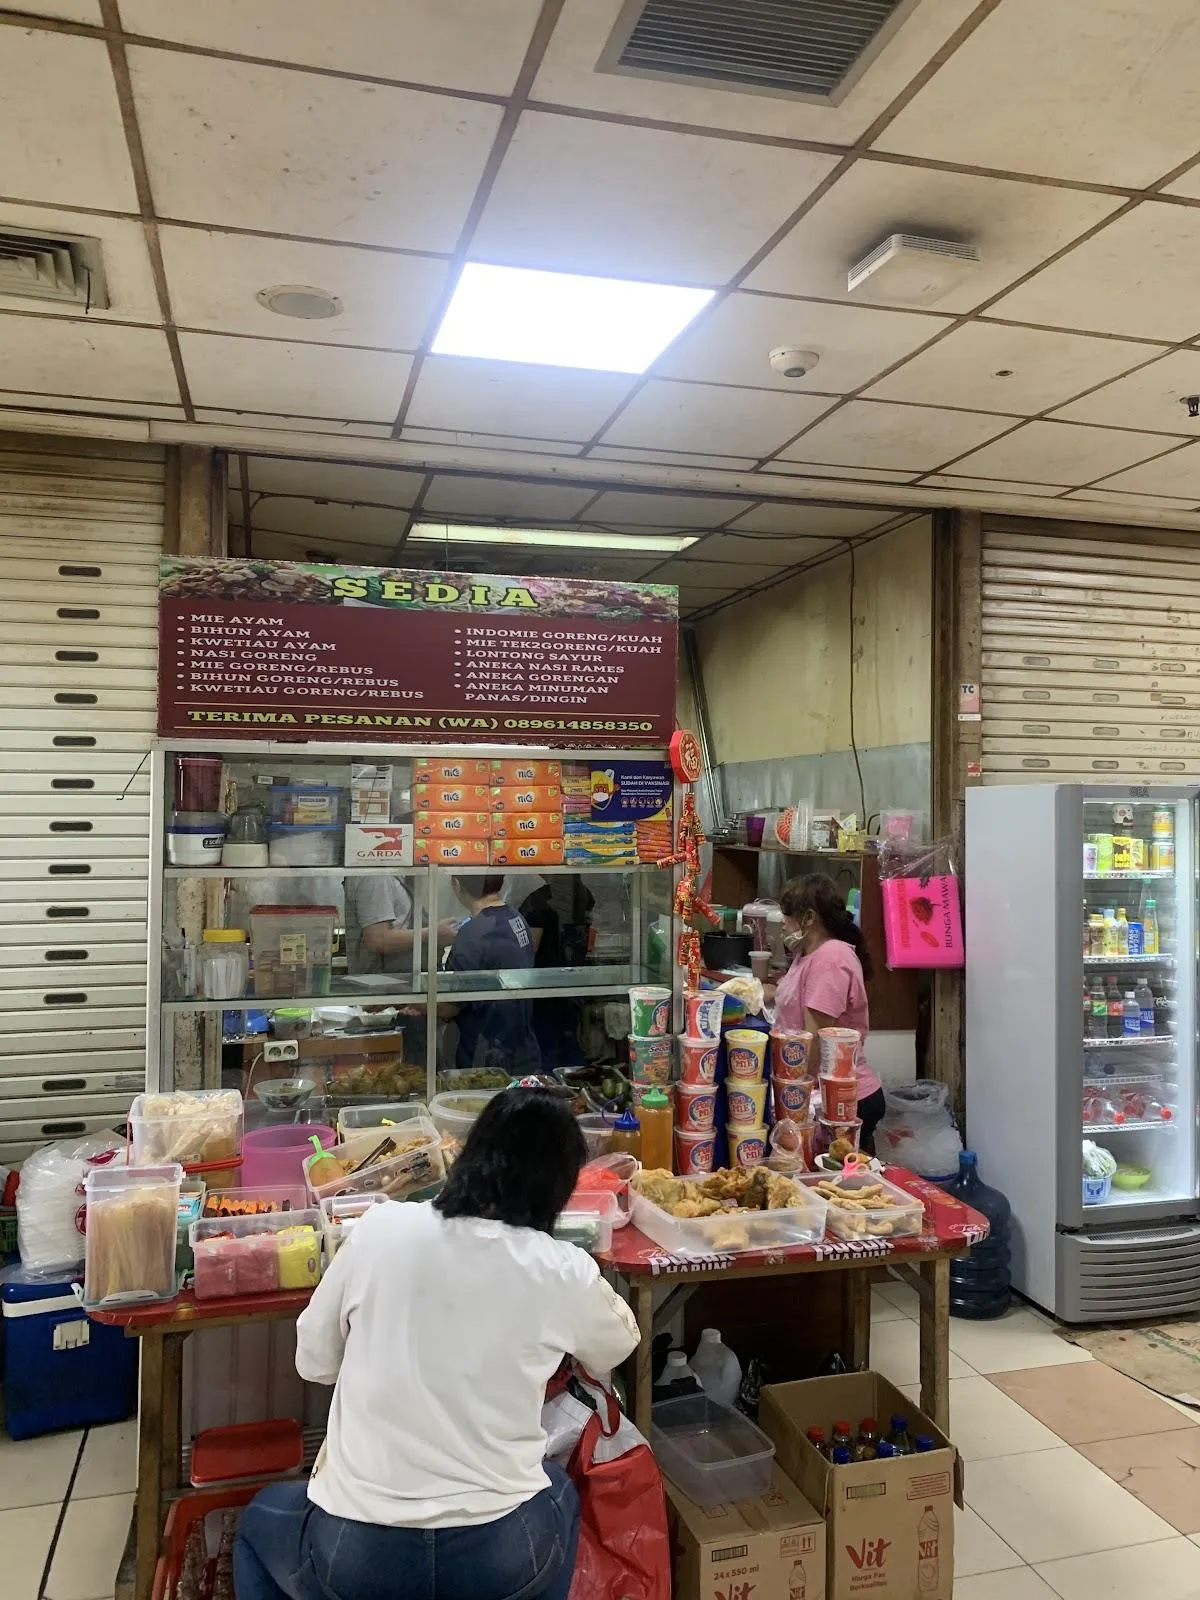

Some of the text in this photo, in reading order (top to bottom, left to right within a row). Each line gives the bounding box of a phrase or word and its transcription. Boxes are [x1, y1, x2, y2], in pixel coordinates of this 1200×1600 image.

[332, 577, 539, 608] SEDIA
[190, 614, 284, 626] MIE AYAM
[190, 626, 311, 639] BIHUN AYAM
[466, 628, 663, 643] INDOMIE GORENG/KUAH
[190, 638, 337, 651] KWETIAU AYAM
[466, 639, 662, 654] MIE TEK2GORENG/KUAH
[190, 649, 317, 662] NASI GORENG
[466, 650, 603, 662] LONTONG SAYUR
[190, 661, 374, 675] MIE GORENG/REBUS
[466, 661, 625, 674] ANEKA NASI RAMES
[190, 672, 399, 687] BIHUN GORENG/REBUS
[466, 671, 619, 684] ANEKA GORENGAN
[190, 684, 424, 699] KWETIAU GORENG/REBUS
[466, 682, 609, 694] ANEKA MINUMAN
[464, 693, 588, 704] PANAS/DINGIN
[187, 710, 653, 731] TERIMA PESANAN (WA) 089614858350
[944, 911, 953, 949] BUNGA
[845, 1538, 892, 1569] Vit
[749, 1564, 760, 1573] ml
